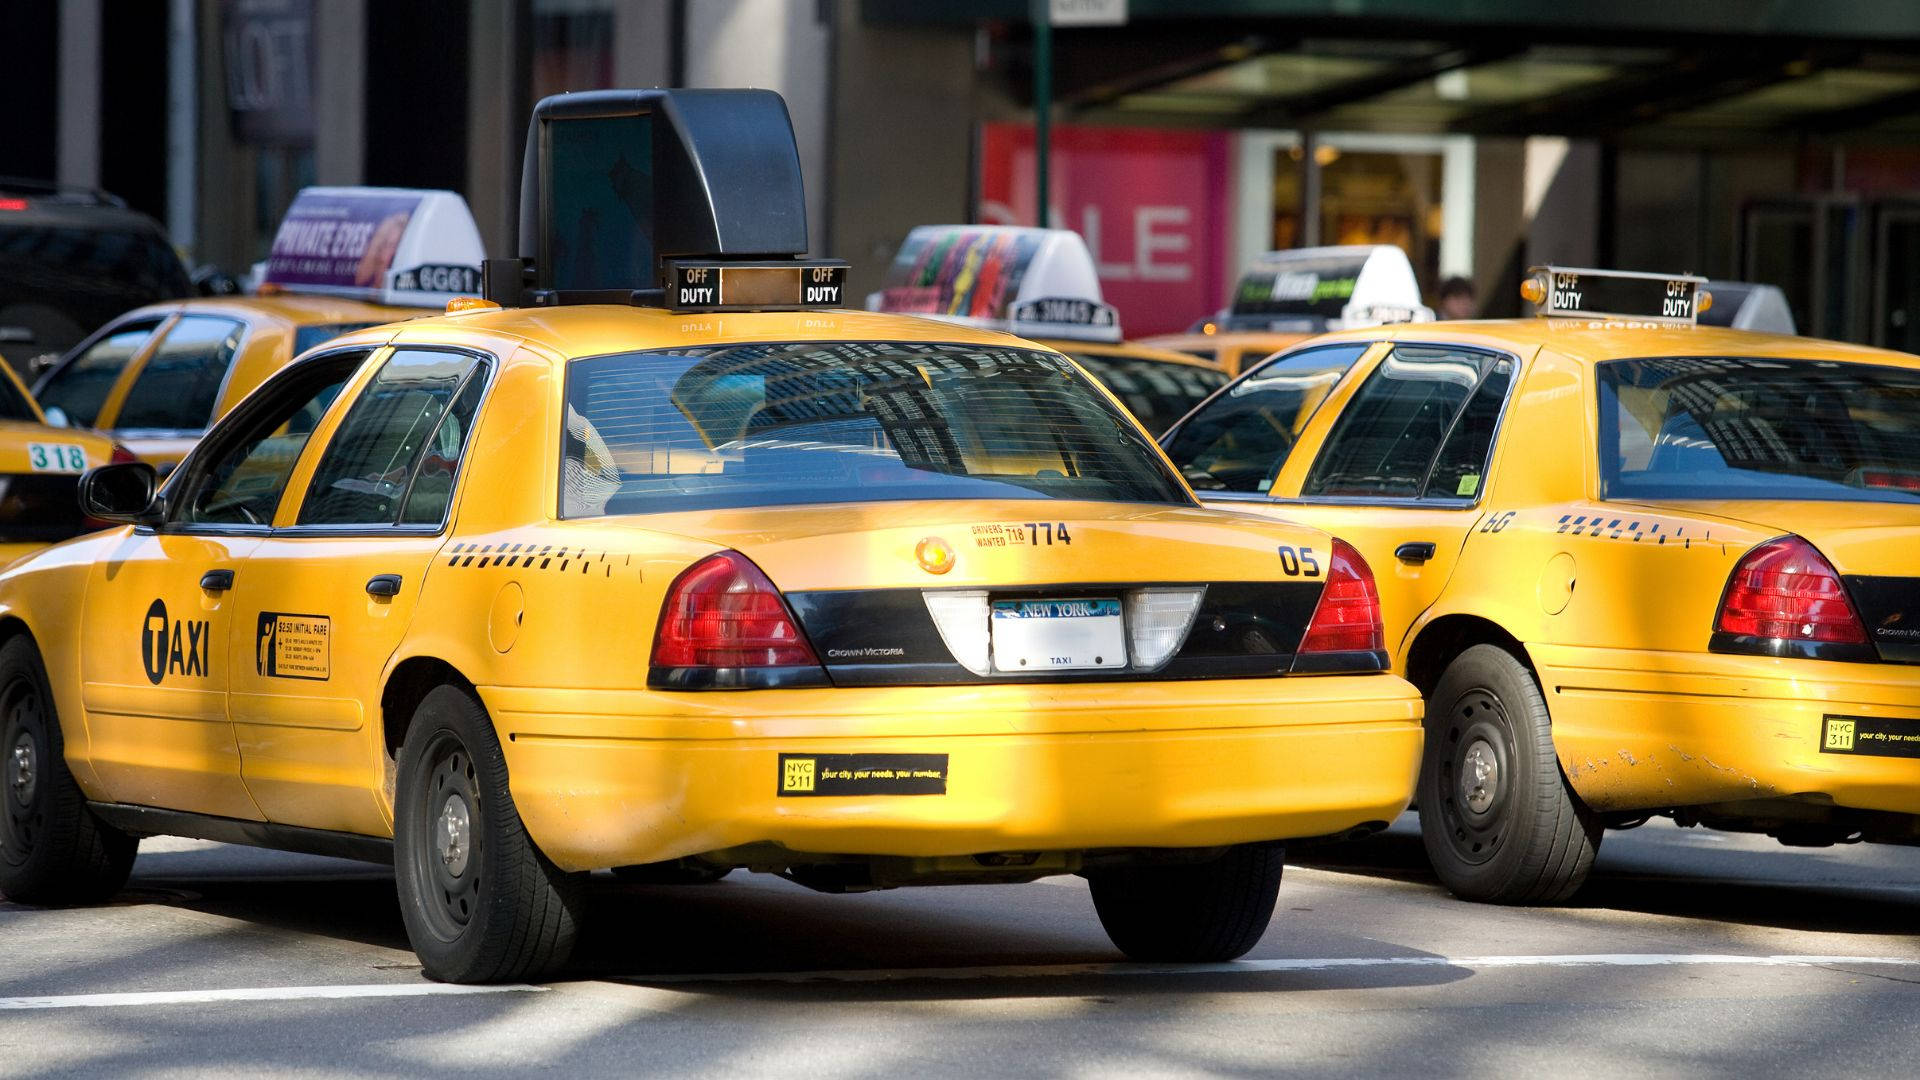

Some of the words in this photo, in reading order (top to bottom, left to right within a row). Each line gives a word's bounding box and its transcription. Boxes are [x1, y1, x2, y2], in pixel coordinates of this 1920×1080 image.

[272, 221, 337, 257] PRIVATE
[332, 222, 374, 258] EYES
[418, 266, 475, 292] 6G61
[687, 269, 708, 284] OFF
[812, 268, 834, 283] OFF
[1557, 273, 1579, 290] OFF
[681, 288, 713, 304] DUTY
[807, 287, 839, 302] DUTY
[1666, 281, 1688, 298] OFF
[1553, 291, 1582, 310] DUTY
[1662, 298, 1690, 318] DUTY
[31, 443, 86, 470] 318
[972, 524, 1003, 534] DRIVERS
[1006, 528, 1025, 541] 718
[1024, 522, 1072, 546] 774
[976, 536, 1006, 547] WANTED
[1278, 545, 1320, 577] 05
[1024, 603, 1052, 618] NEW
[1055, 602, 1090, 617] YORK
[313, 624, 327, 636] FARE
[147, 614, 209, 678] TAXI
[827, 649, 863, 657] CROWN
[864, 647, 904, 656] VICTORIA
[1049, 656, 1073, 665] TAXI
[1829, 723, 1852, 733] NYC
[1829, 734, 1850, 746] 311
[1859, 732, 1875, 741] your
[1888, 734, 1903, 742] your
[787, 763, 813, 773] NYC
[821, 770, 838, 781] your
[854, 769, 871, 780] your
[787, 775, 811, 788] 311
